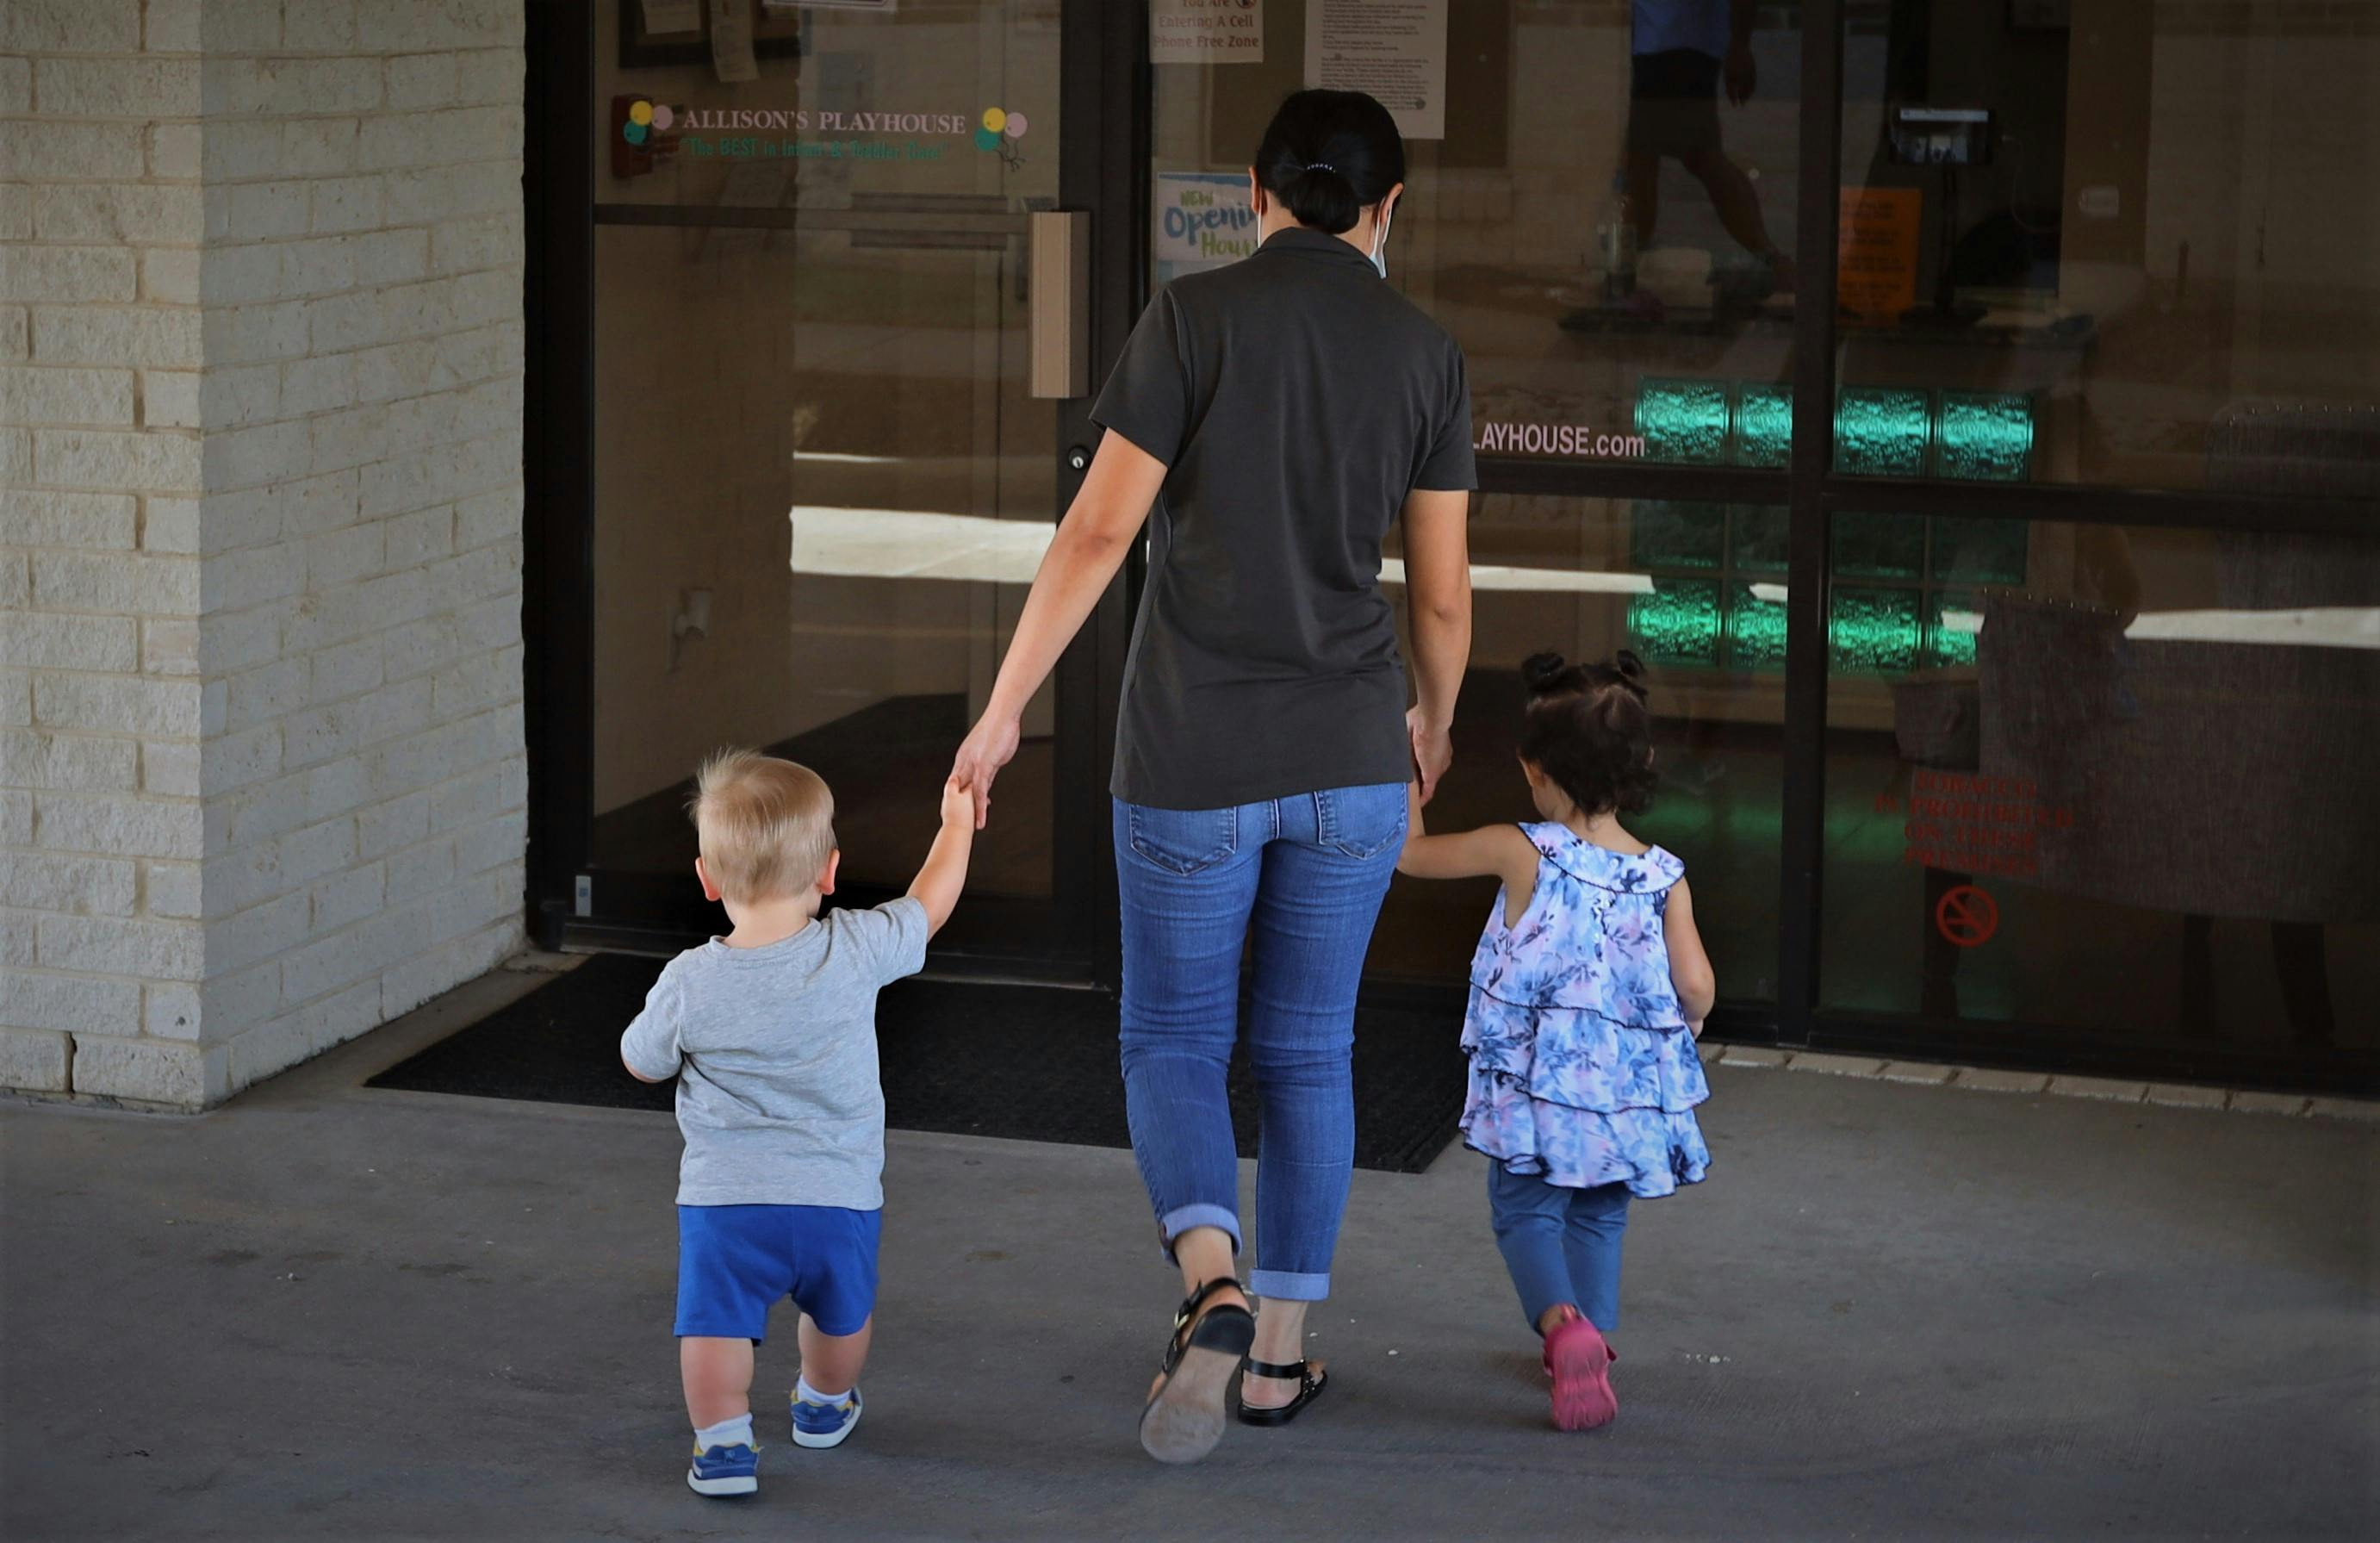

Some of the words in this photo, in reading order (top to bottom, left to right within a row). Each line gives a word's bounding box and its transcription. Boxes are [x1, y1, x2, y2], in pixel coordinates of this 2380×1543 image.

[1159, 16, 1213, 29] Entering
[1218, 16, 1226, 28] A
[1230, 15, 1254, 28] Cell
[1155, 34, 1193, 47] Phone
[1197, 35, 1224, 47] Free
[1228, 35, 1259, 47] Zone
[682, 109, 809, 129] ALLISON'S
[818, 111, 966, 134] PLAYHOUSE
[720, 138, 758, 156] BEST
[765, 140, 776, 157] in
[831, 140, 842, 159] &
[1180, 190, 1214, 207] NEW
[1202, 231, 1255, 258] Hour
[1910, 794, 2074, 827] PROHIBITED
